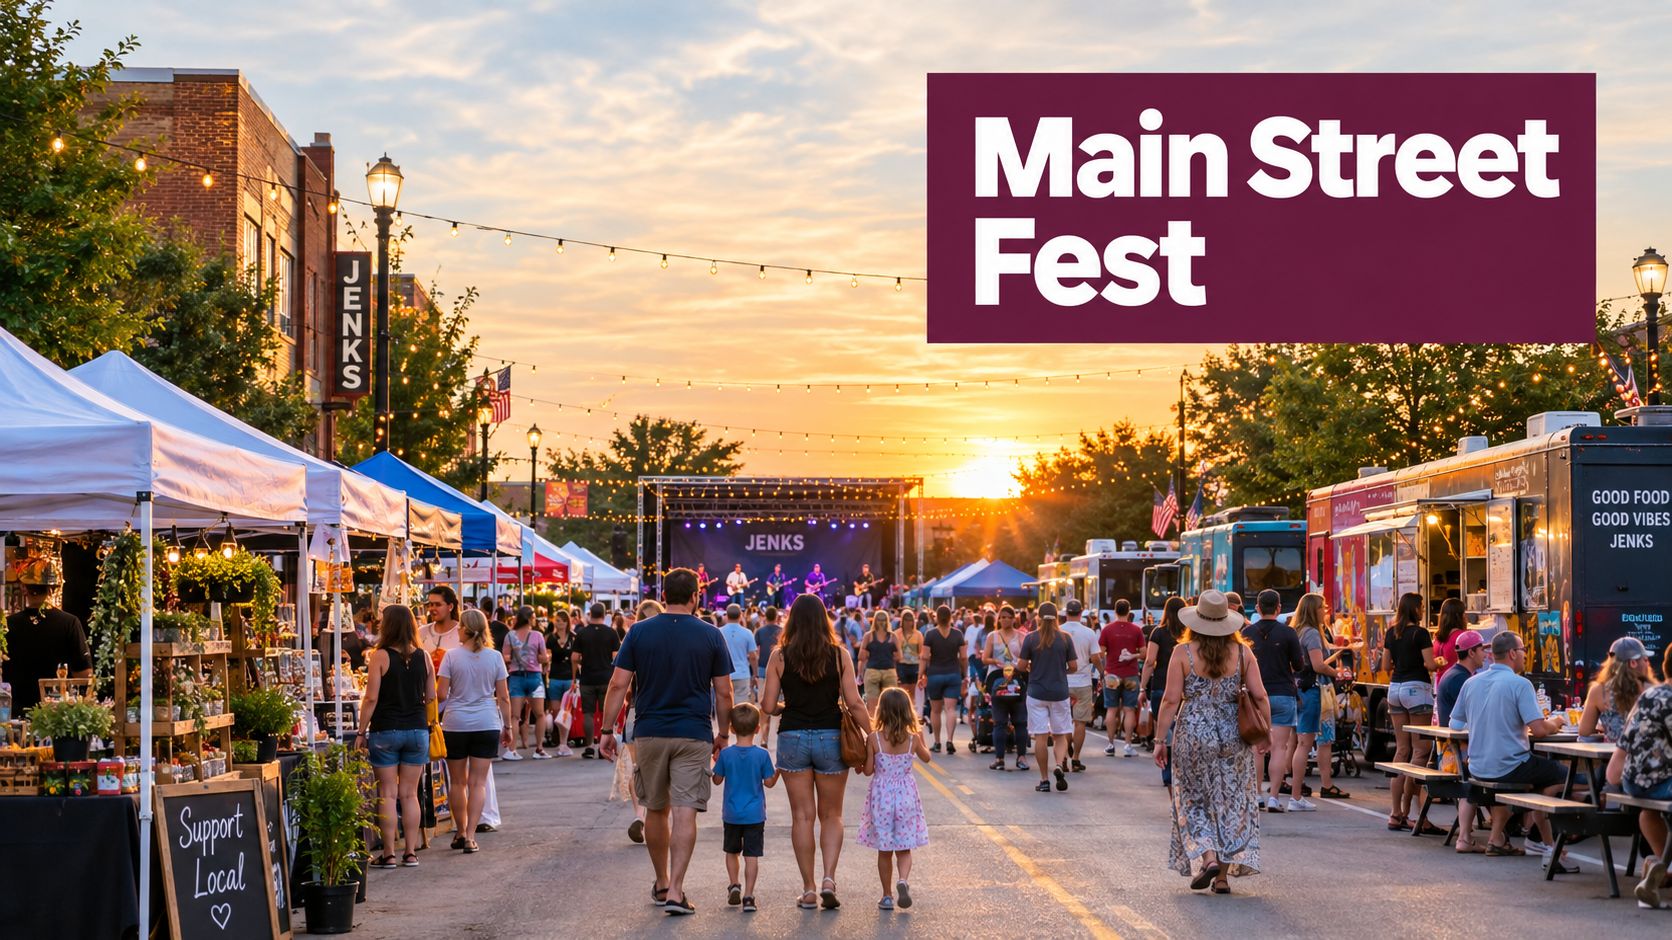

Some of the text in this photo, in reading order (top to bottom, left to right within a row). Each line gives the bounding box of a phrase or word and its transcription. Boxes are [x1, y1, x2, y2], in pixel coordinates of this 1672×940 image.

[341, 259, 363, 389] JENKS
[1592, 490, 1670, 504] GOOD FOOD
[1592, 512, 1671, 526] GOOD VIBES
[745, 534, 805, 551] JENKS
[1610, 534, 1653, 548] JENKS
[179, 803, 243, 857] Support
[194, 852, 246, 899] Local
